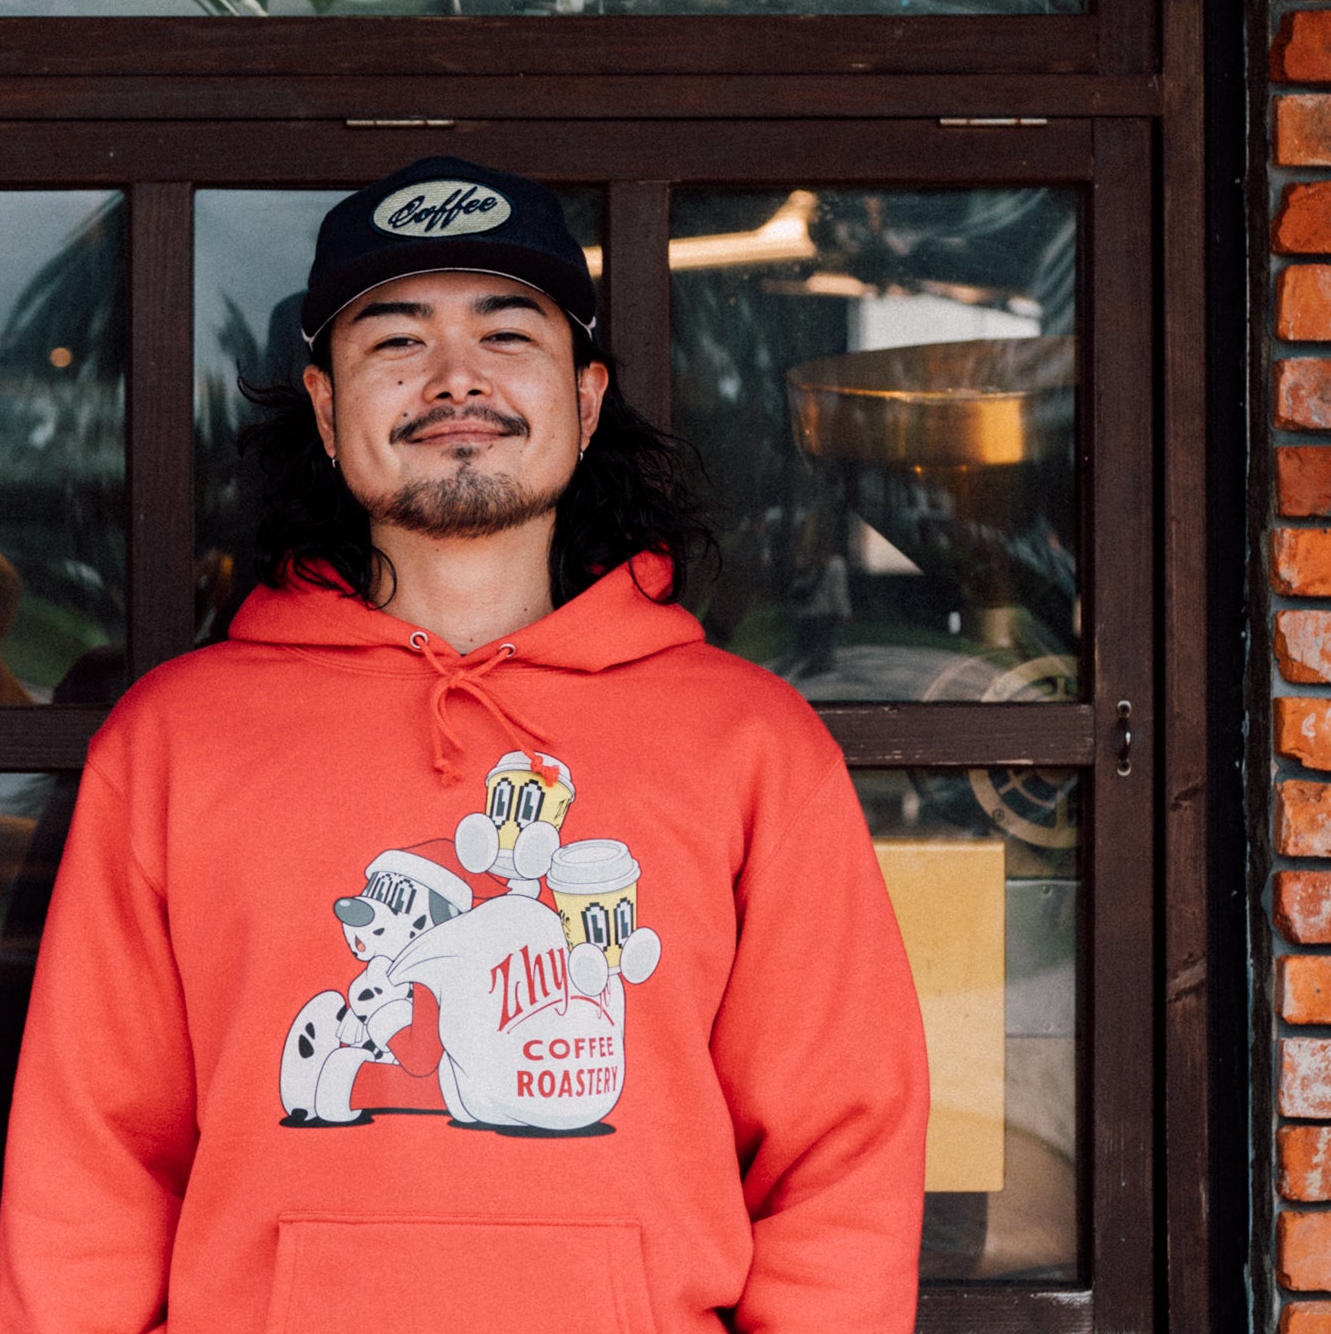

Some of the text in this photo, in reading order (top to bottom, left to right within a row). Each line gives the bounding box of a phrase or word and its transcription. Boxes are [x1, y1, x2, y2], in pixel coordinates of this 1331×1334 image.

[387, 185, 498, 233] Coffee
[488, 944, 582, 1032] Zhy
[522, 1036, 615, 1062] COFFEE
[516, 1065, 619, 1098] ROASTERY
